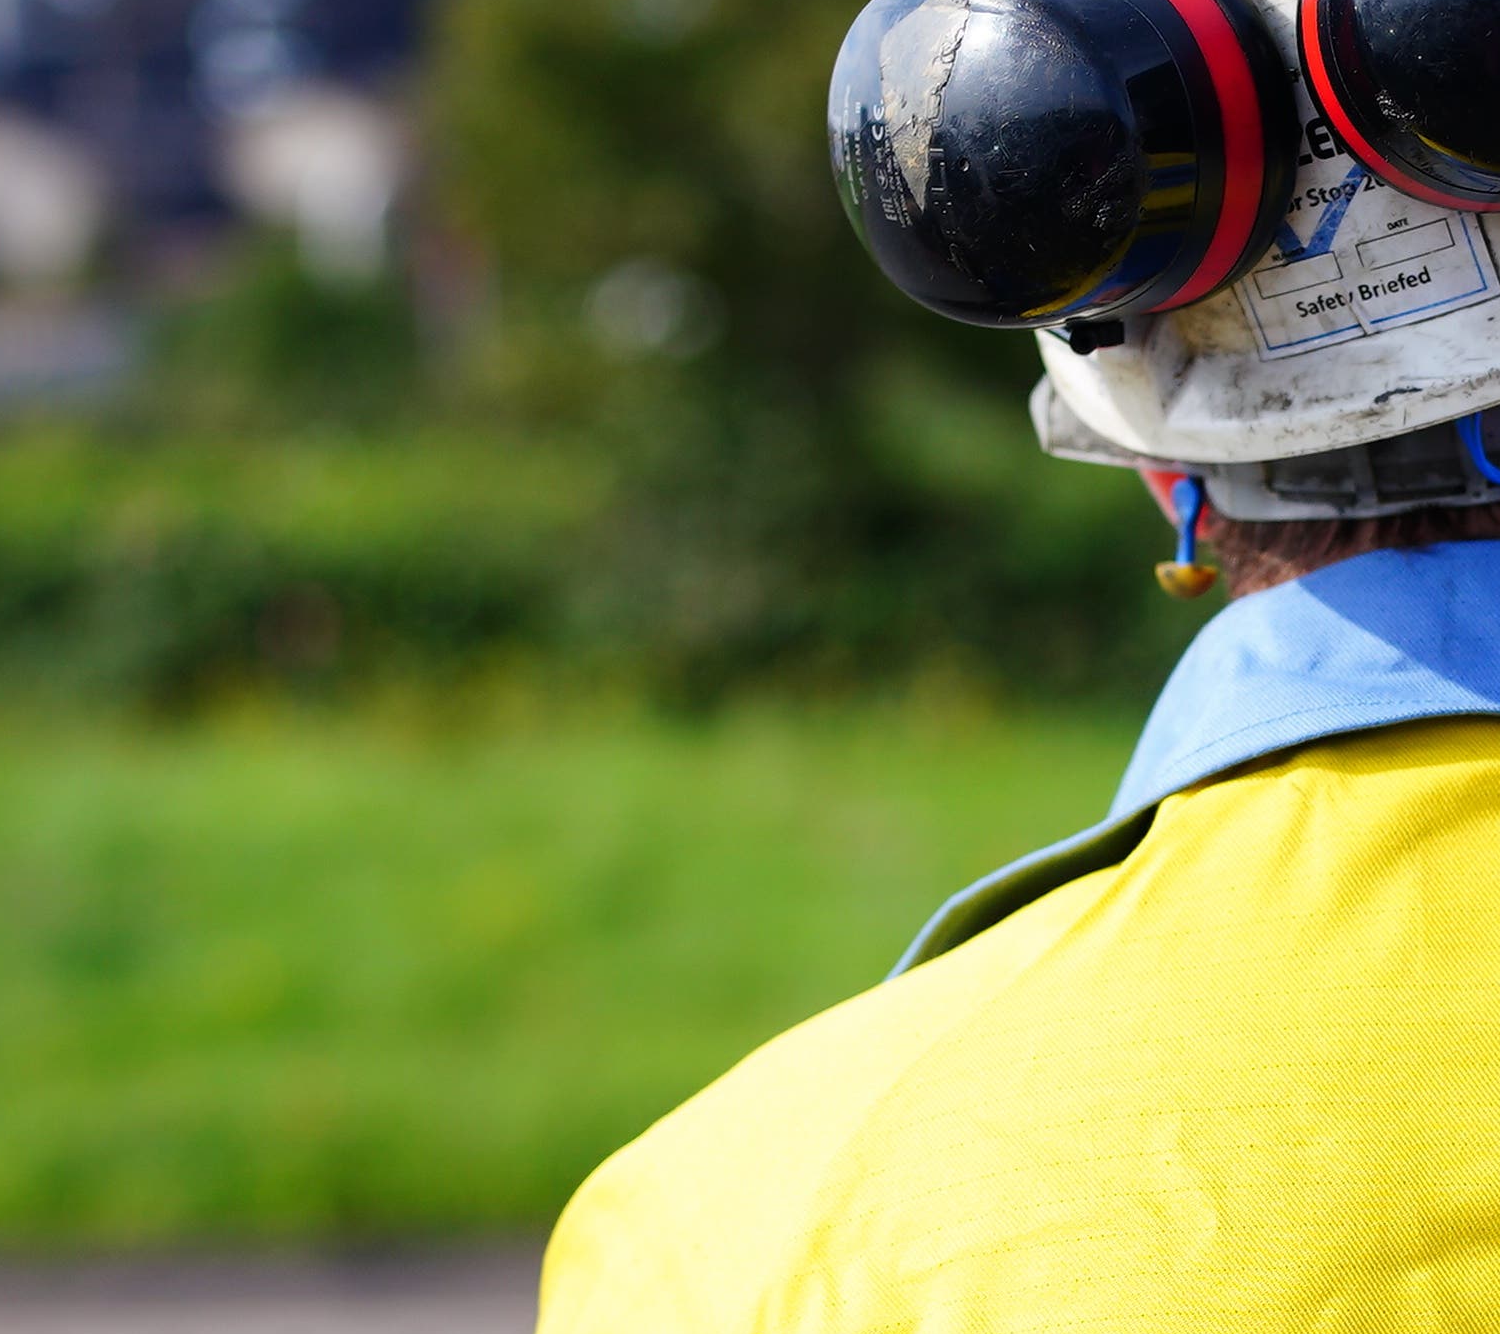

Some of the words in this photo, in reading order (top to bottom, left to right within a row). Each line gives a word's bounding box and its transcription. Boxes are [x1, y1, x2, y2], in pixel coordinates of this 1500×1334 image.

[1306, 182, 1356, 207] Stop
[1386, 217, 1409, 231] DATE
[1358, 266, 1432, 302] Briefed
